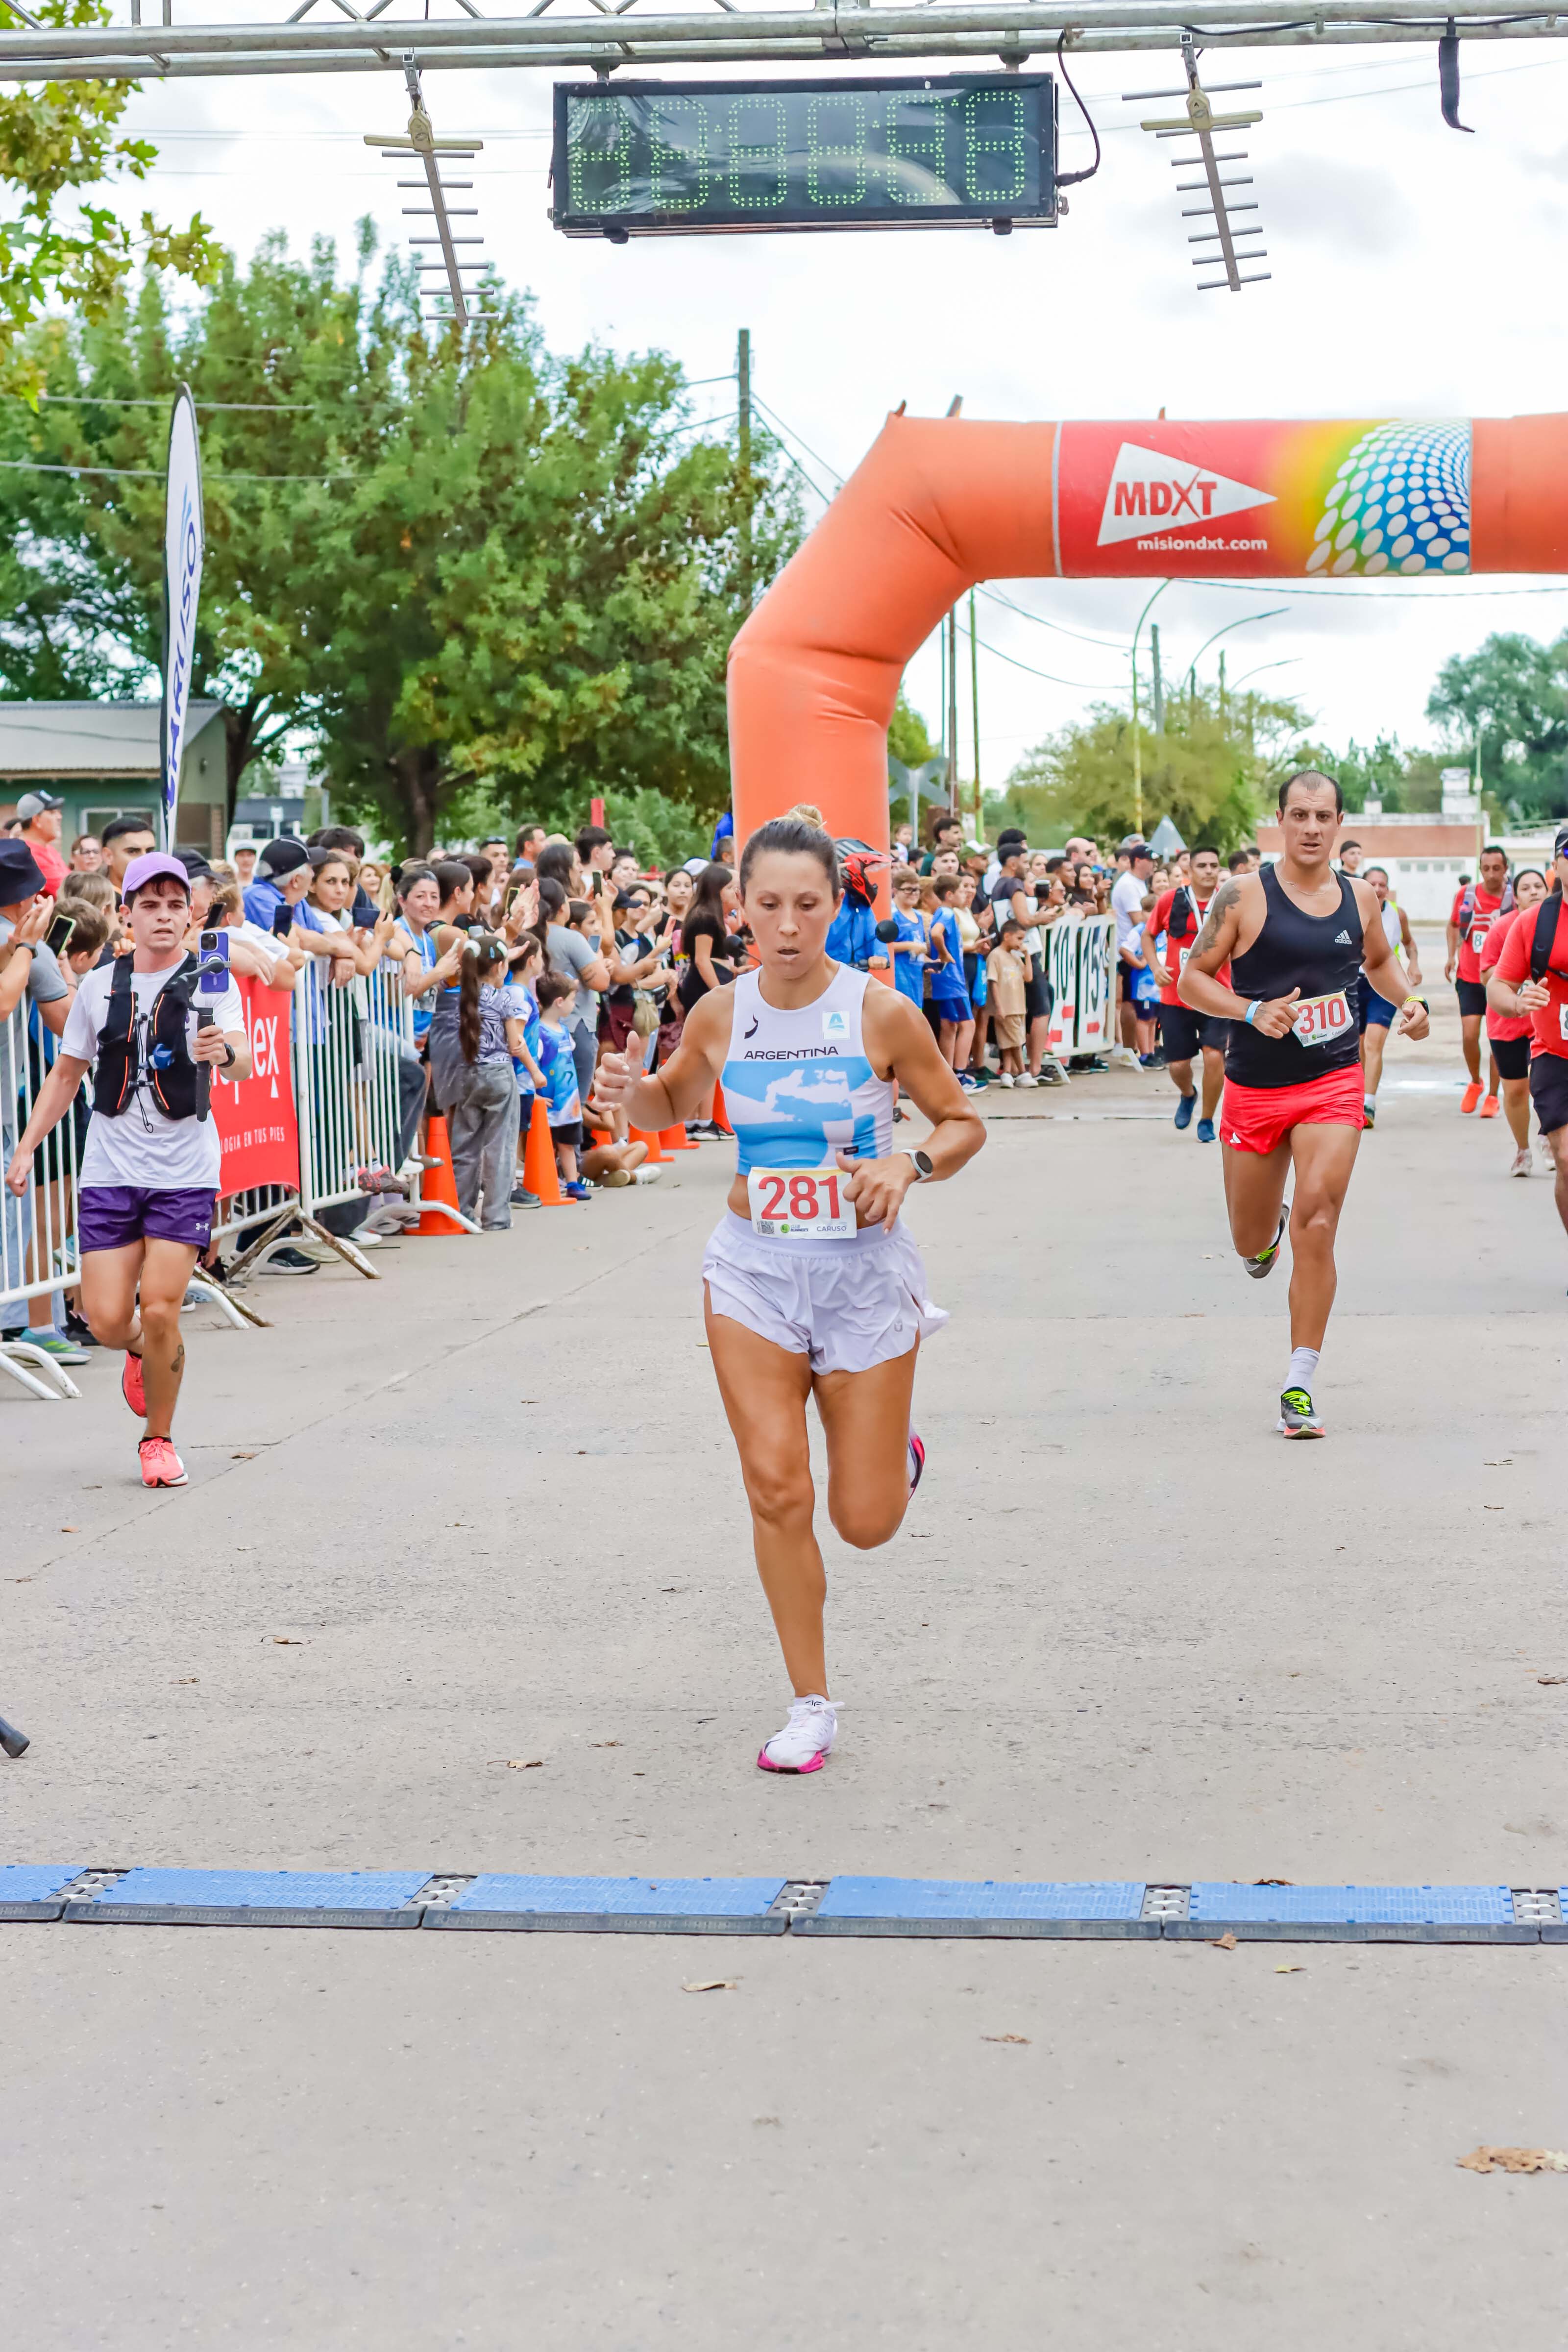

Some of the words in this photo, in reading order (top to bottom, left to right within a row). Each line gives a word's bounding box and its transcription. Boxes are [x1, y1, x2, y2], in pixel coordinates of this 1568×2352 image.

[1114, 468, 1218, 519] MDXT
[1137, 537, 1267, 551] misiondxt.com
[1297, 998, 1346, 1034] 310
[744, 1046, 839, 1060] ARGENTINA
[254, 1128, 267, 1144] TUS
[270, 1126, 285, 1142] PIES
[758, 1175, 840, 1220] 281
